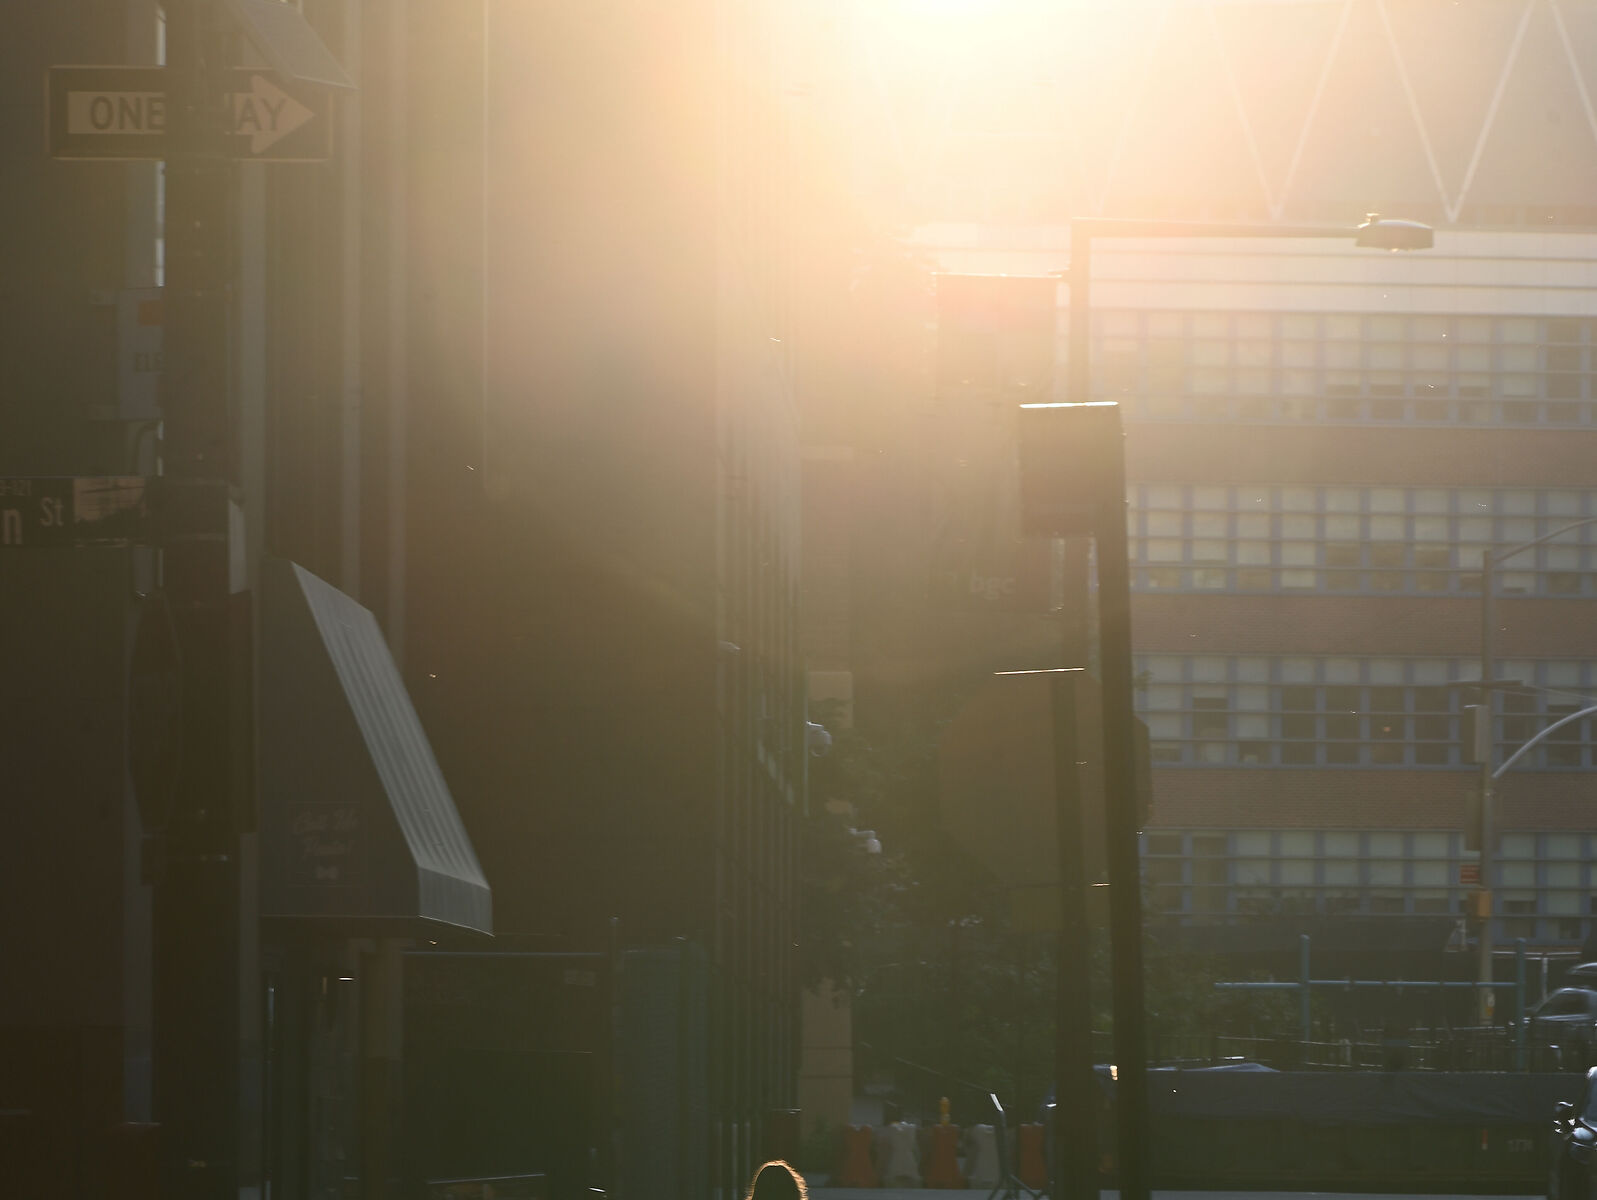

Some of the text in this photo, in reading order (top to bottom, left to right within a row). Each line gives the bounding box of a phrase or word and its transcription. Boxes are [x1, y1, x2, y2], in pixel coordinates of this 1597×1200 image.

[91, 96, 286, 131] ONE AY
[40, 497, 64, 527] St
